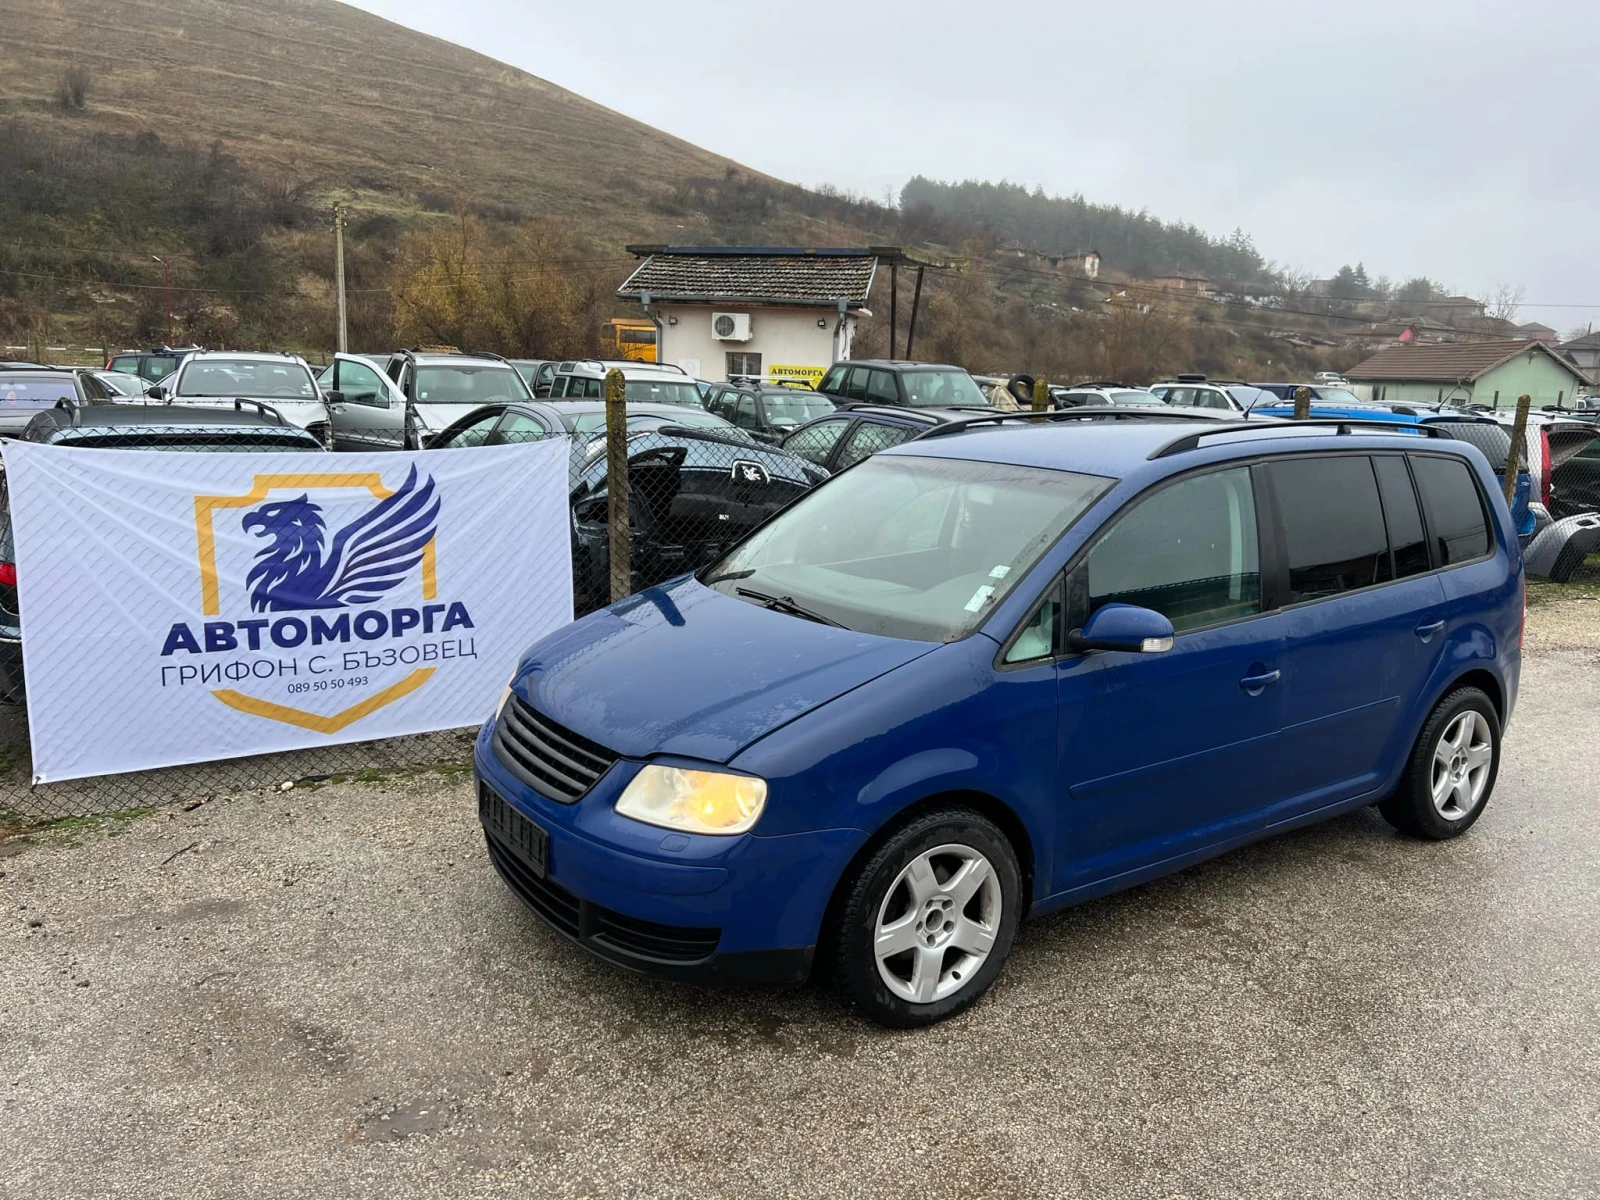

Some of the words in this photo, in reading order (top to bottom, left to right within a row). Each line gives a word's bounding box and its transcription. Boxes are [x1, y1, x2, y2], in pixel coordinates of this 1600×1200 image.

[771, 368, 823, 377] АВТОМОРГА
[160, 601, 475, 656] АВТОМОРГА
[161, 657, 298, 687] ГРИФОН
[308, 655, 333, 674] С.
[343, 637, 478, 671] БЪЗОВЕЦ
[287, 682, 310, 694] 089
[313, 680, 328, 692] 50
[330, 678, 345, 690] 50
[347, 676, 369, 687] 493
